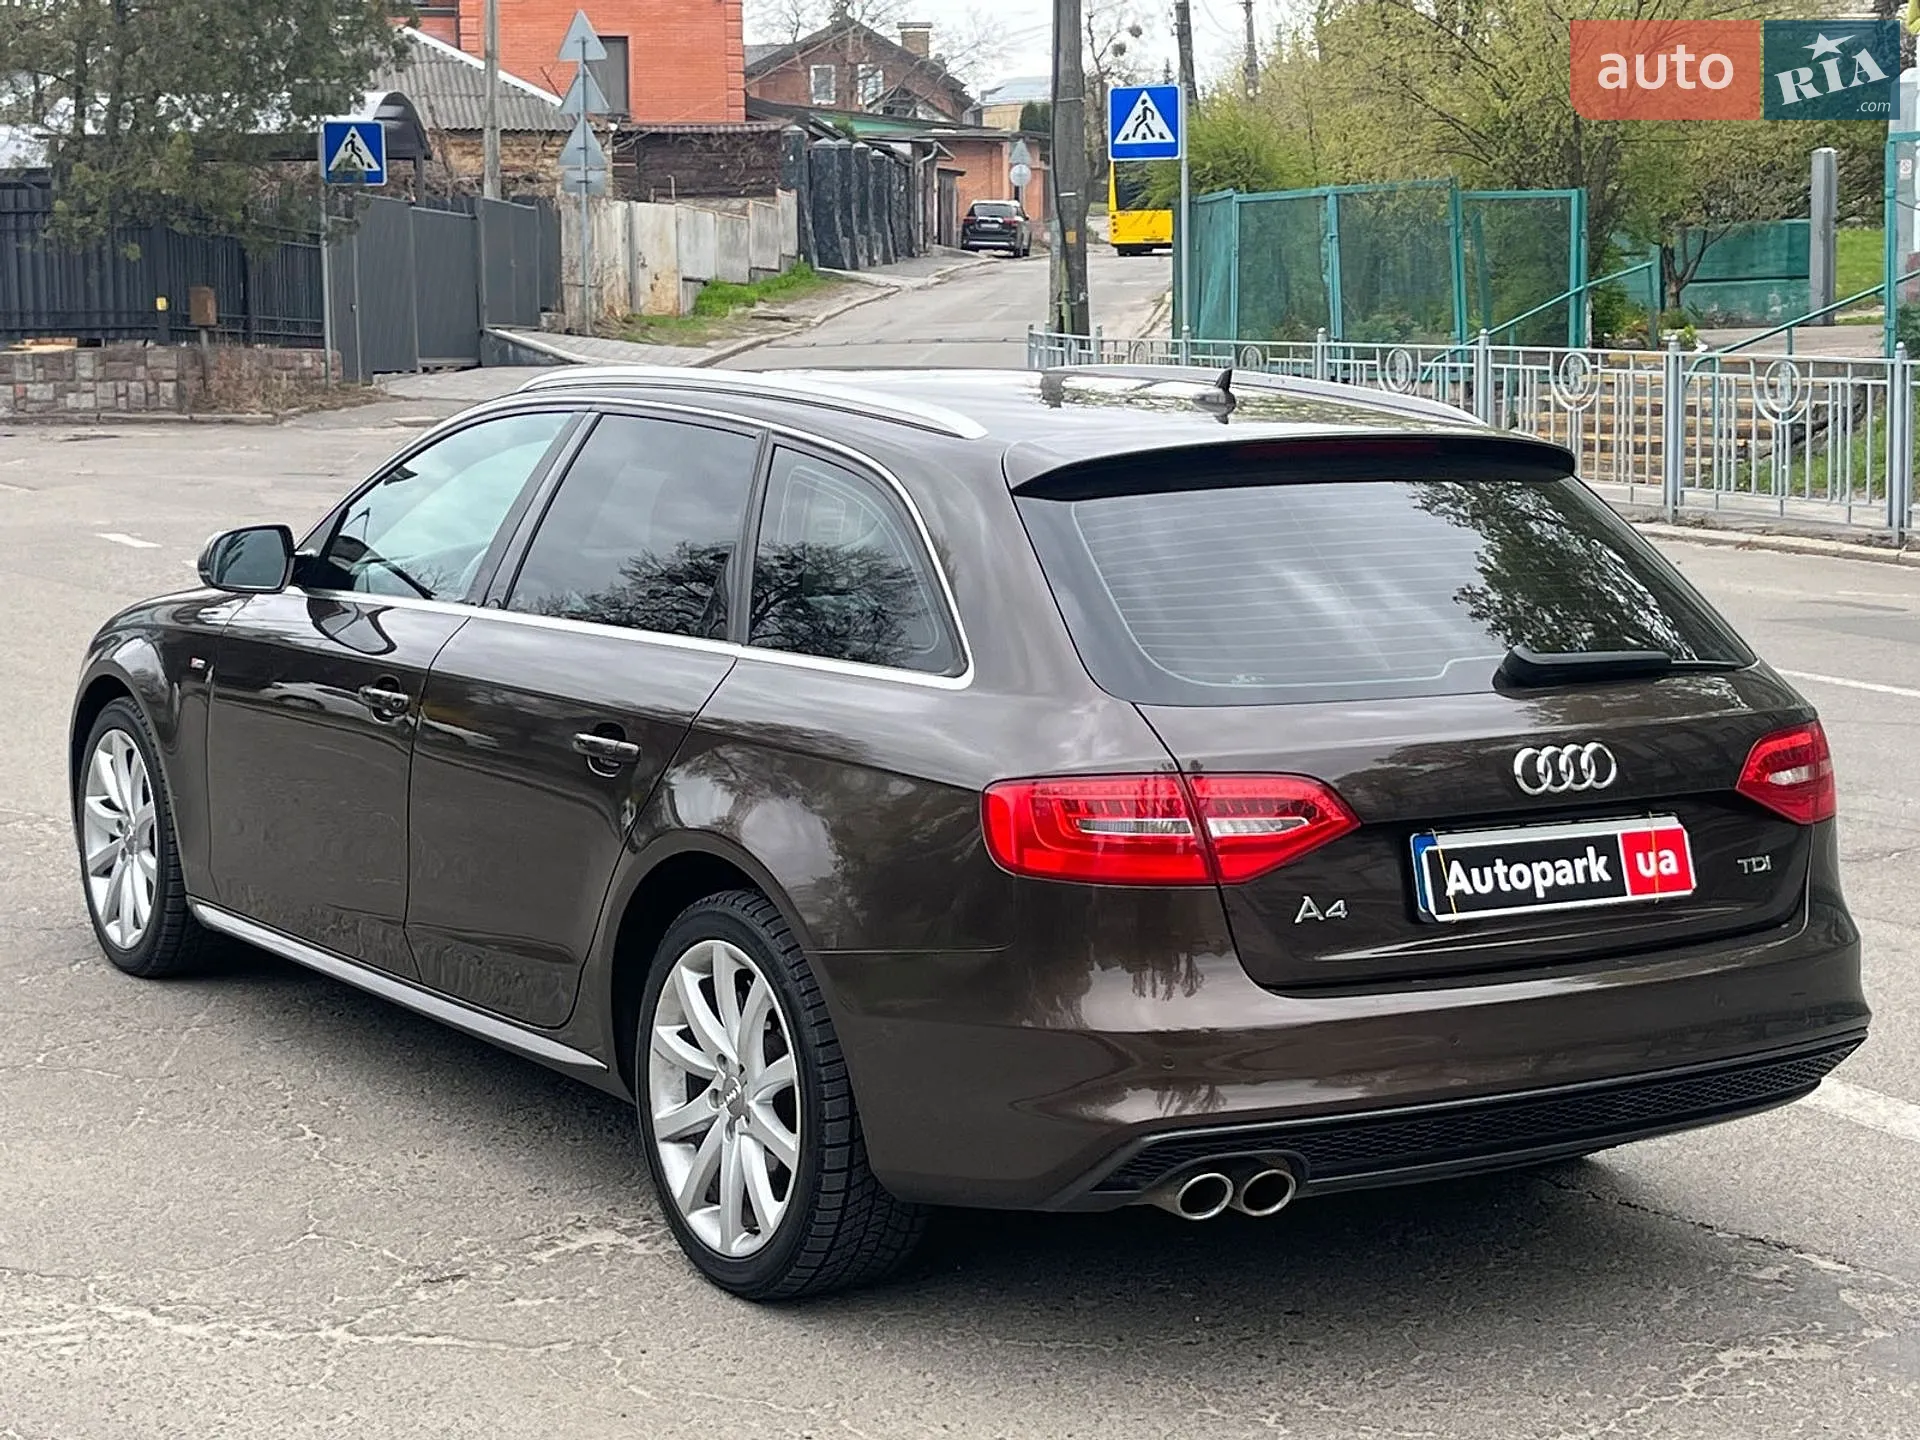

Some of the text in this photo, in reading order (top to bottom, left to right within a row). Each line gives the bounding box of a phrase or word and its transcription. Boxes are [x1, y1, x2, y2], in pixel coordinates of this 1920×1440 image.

[1446, 845, 1679, 899] Autopark ua
[1736, 854, 1772, 874] TDI
[1294, 895, 1348, 924] A4
